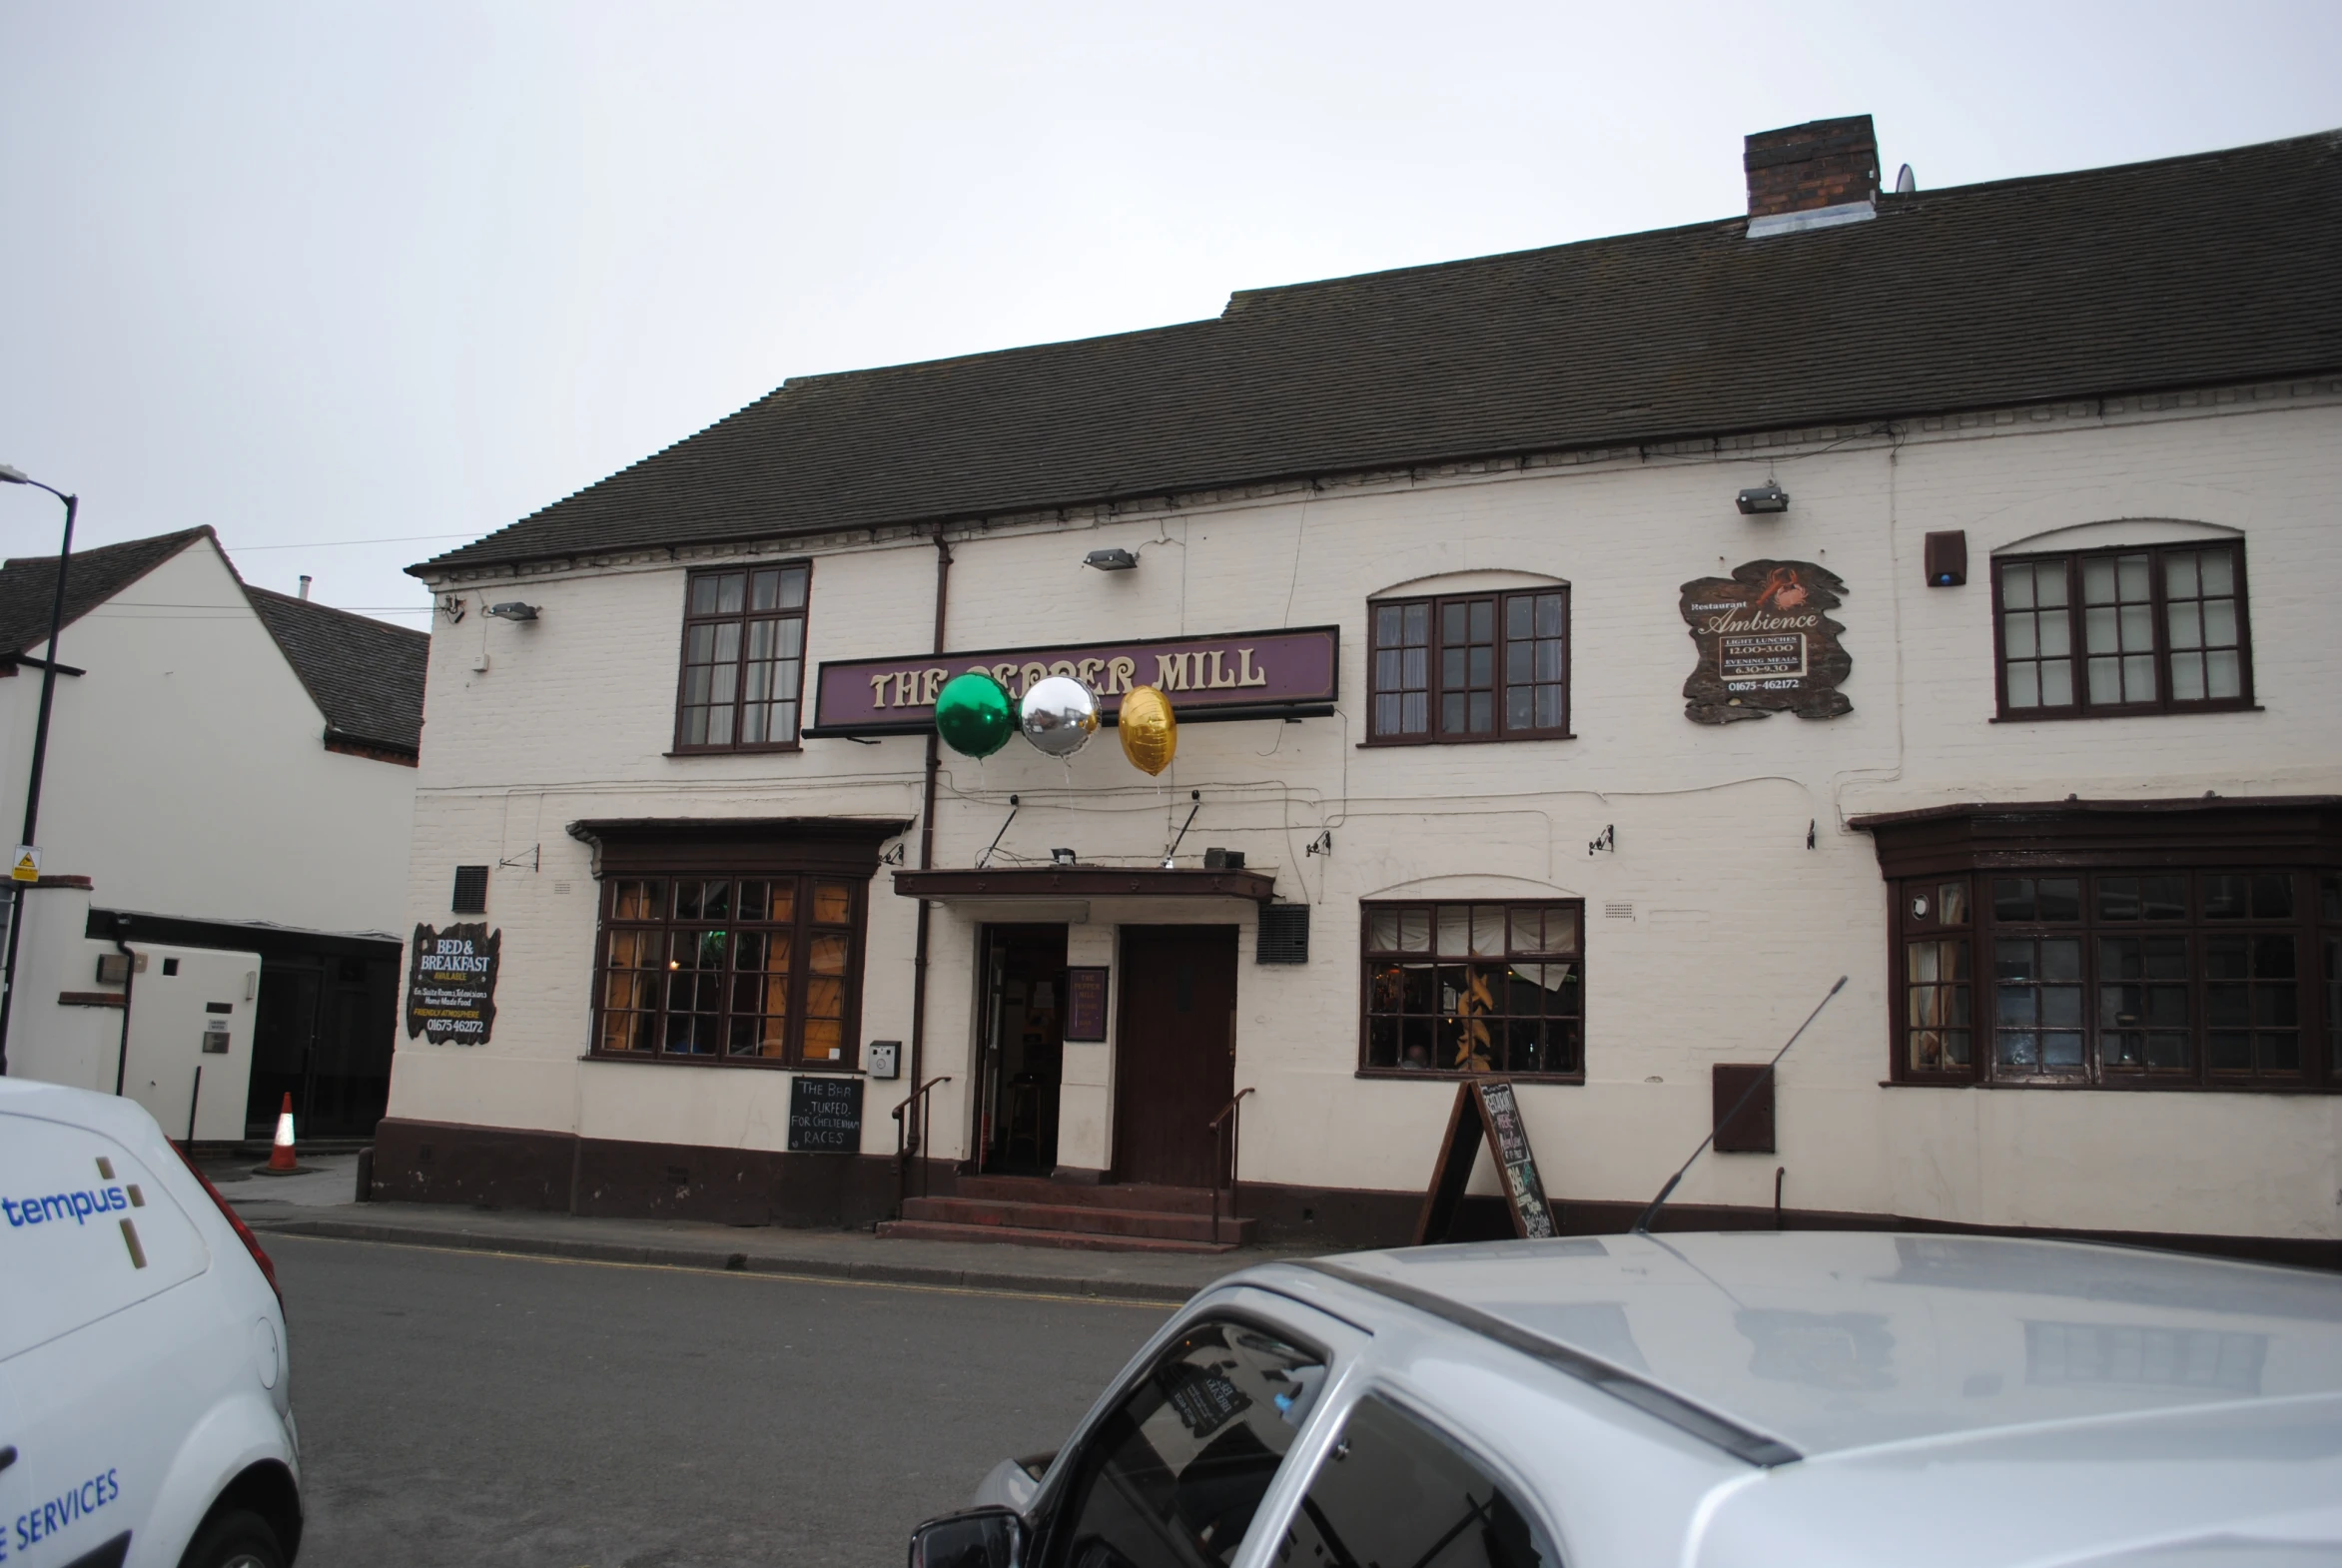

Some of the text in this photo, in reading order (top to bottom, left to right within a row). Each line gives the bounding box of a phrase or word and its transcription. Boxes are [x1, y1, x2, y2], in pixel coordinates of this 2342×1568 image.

[1691, 601, 1748, 611] Restaurant
[1698, 607, 1819, 634] Ambience
[1153, 648, 1266, 691] MILL
[436, 939, 474, 955] BED &
[420, 955, 490, 972] BREAKFAST
[433, 972, 467, 981] AVAILABLE
[440, 997, 456, 1006] Made
[457, 998, 472, 1007] Food
[413, 1008, 479, 1019] FRIENDLY ATMOSPHERE
[427, 1019, 483, 1033] 01675 462172
[798, 1081, 823, 1096] THE
[791, 1115, 811, 1128] FOR
[804, 1130, 844, 1145] RACES
[1, 1186, 128, 1227] tempus
[16, 1467, 119, 1551] SERVICES
